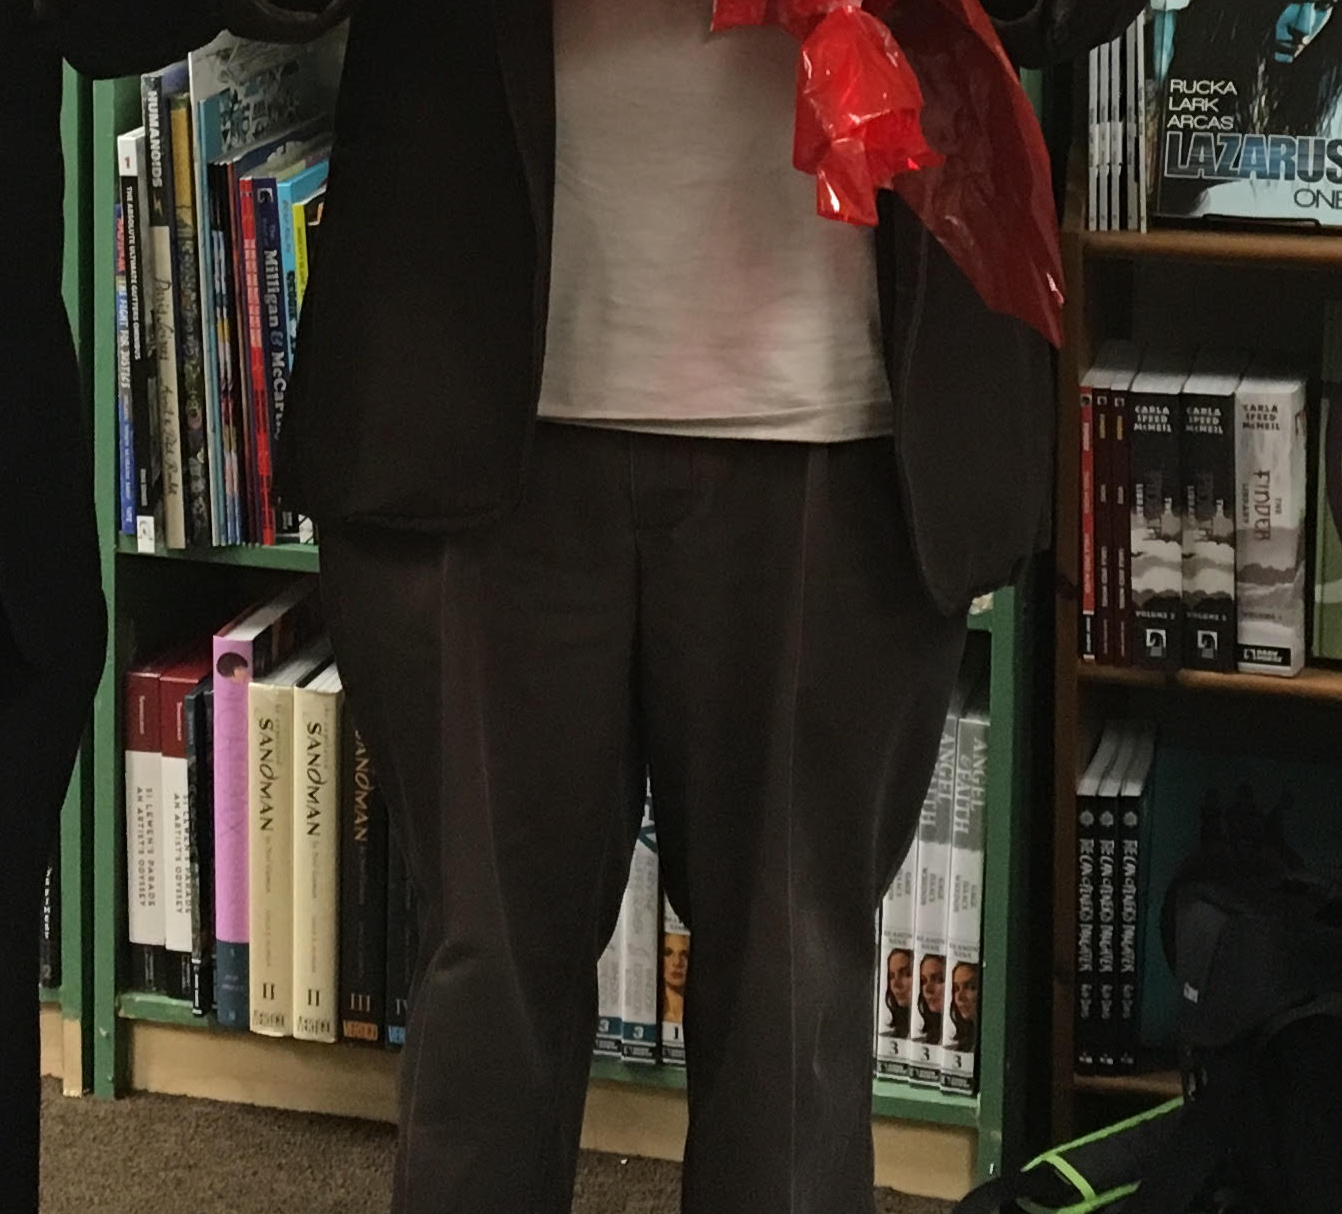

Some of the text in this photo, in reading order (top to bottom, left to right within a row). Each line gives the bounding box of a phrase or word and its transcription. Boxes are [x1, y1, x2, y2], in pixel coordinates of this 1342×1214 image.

[1168, 97, 1219, 112] LARK
[1170, 80, 1237, 96] RUCKA
[147, 89, 163, 188] HUMANOIDS
[1167, 115, 1234, 130] ARCAS
[264, 249, 279, 327] Milligan
[1134, 405, 1170, 415] CARLA
[1137, 414, 1168, 423] SPEED
[1186, 407, 1222, 416] CARLA
[1189, 415, 1220, 425] SPEED
[1243, 404, 1279, 414] CARLA
[1245, 413, 1277, 421] SPEED
[1255, 470, 1271, 540] FINDER
[259, 718, 275, 832] SANDMAN
[306, 722, 328, 836] SANDMAN
[935, 734, 954, 806] ANGEL
[971, 738, 987, 811] ANGEL
[139, 858, 147, 907] ODYSSEY
[148, 857, 157, 907] PARADE
[175, 864, 183, 914] ODYSSEY
[350, 993, 371, 1012] III
